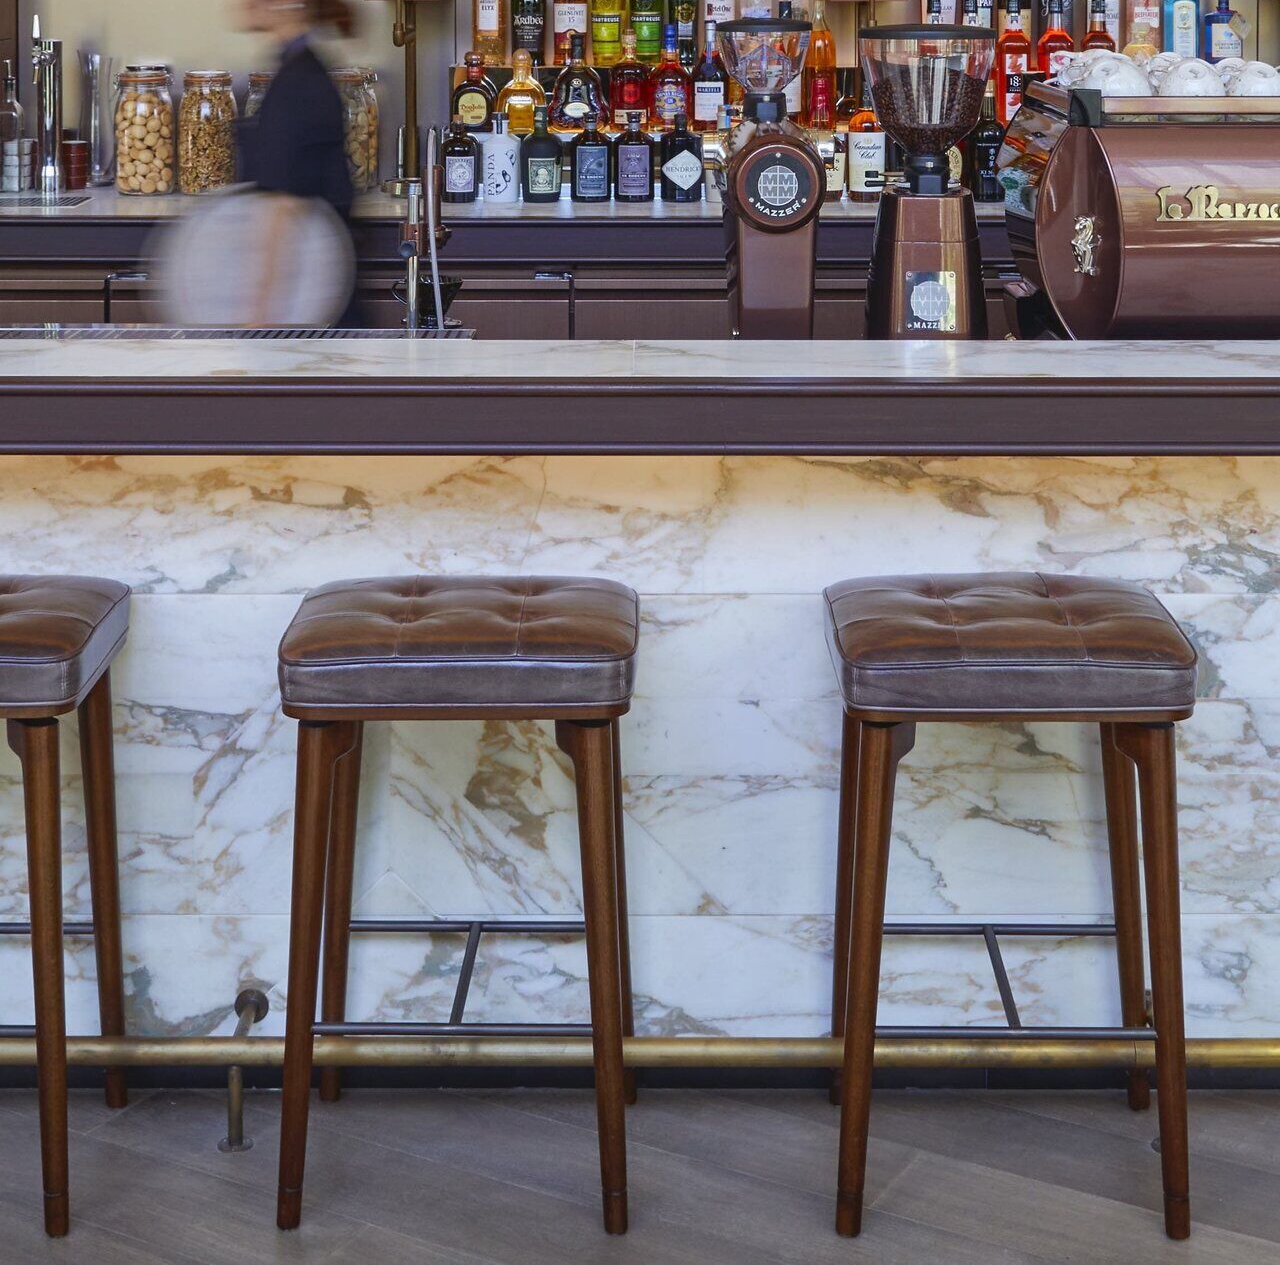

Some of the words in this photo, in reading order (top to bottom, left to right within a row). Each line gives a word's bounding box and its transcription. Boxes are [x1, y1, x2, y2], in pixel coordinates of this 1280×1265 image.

[852, 141, 882, 151] Canadian
[859, 151, 875, 160] Club
[487, 154, 495, 196] PANDA
[755, 201, 800, 217] MAZZER
